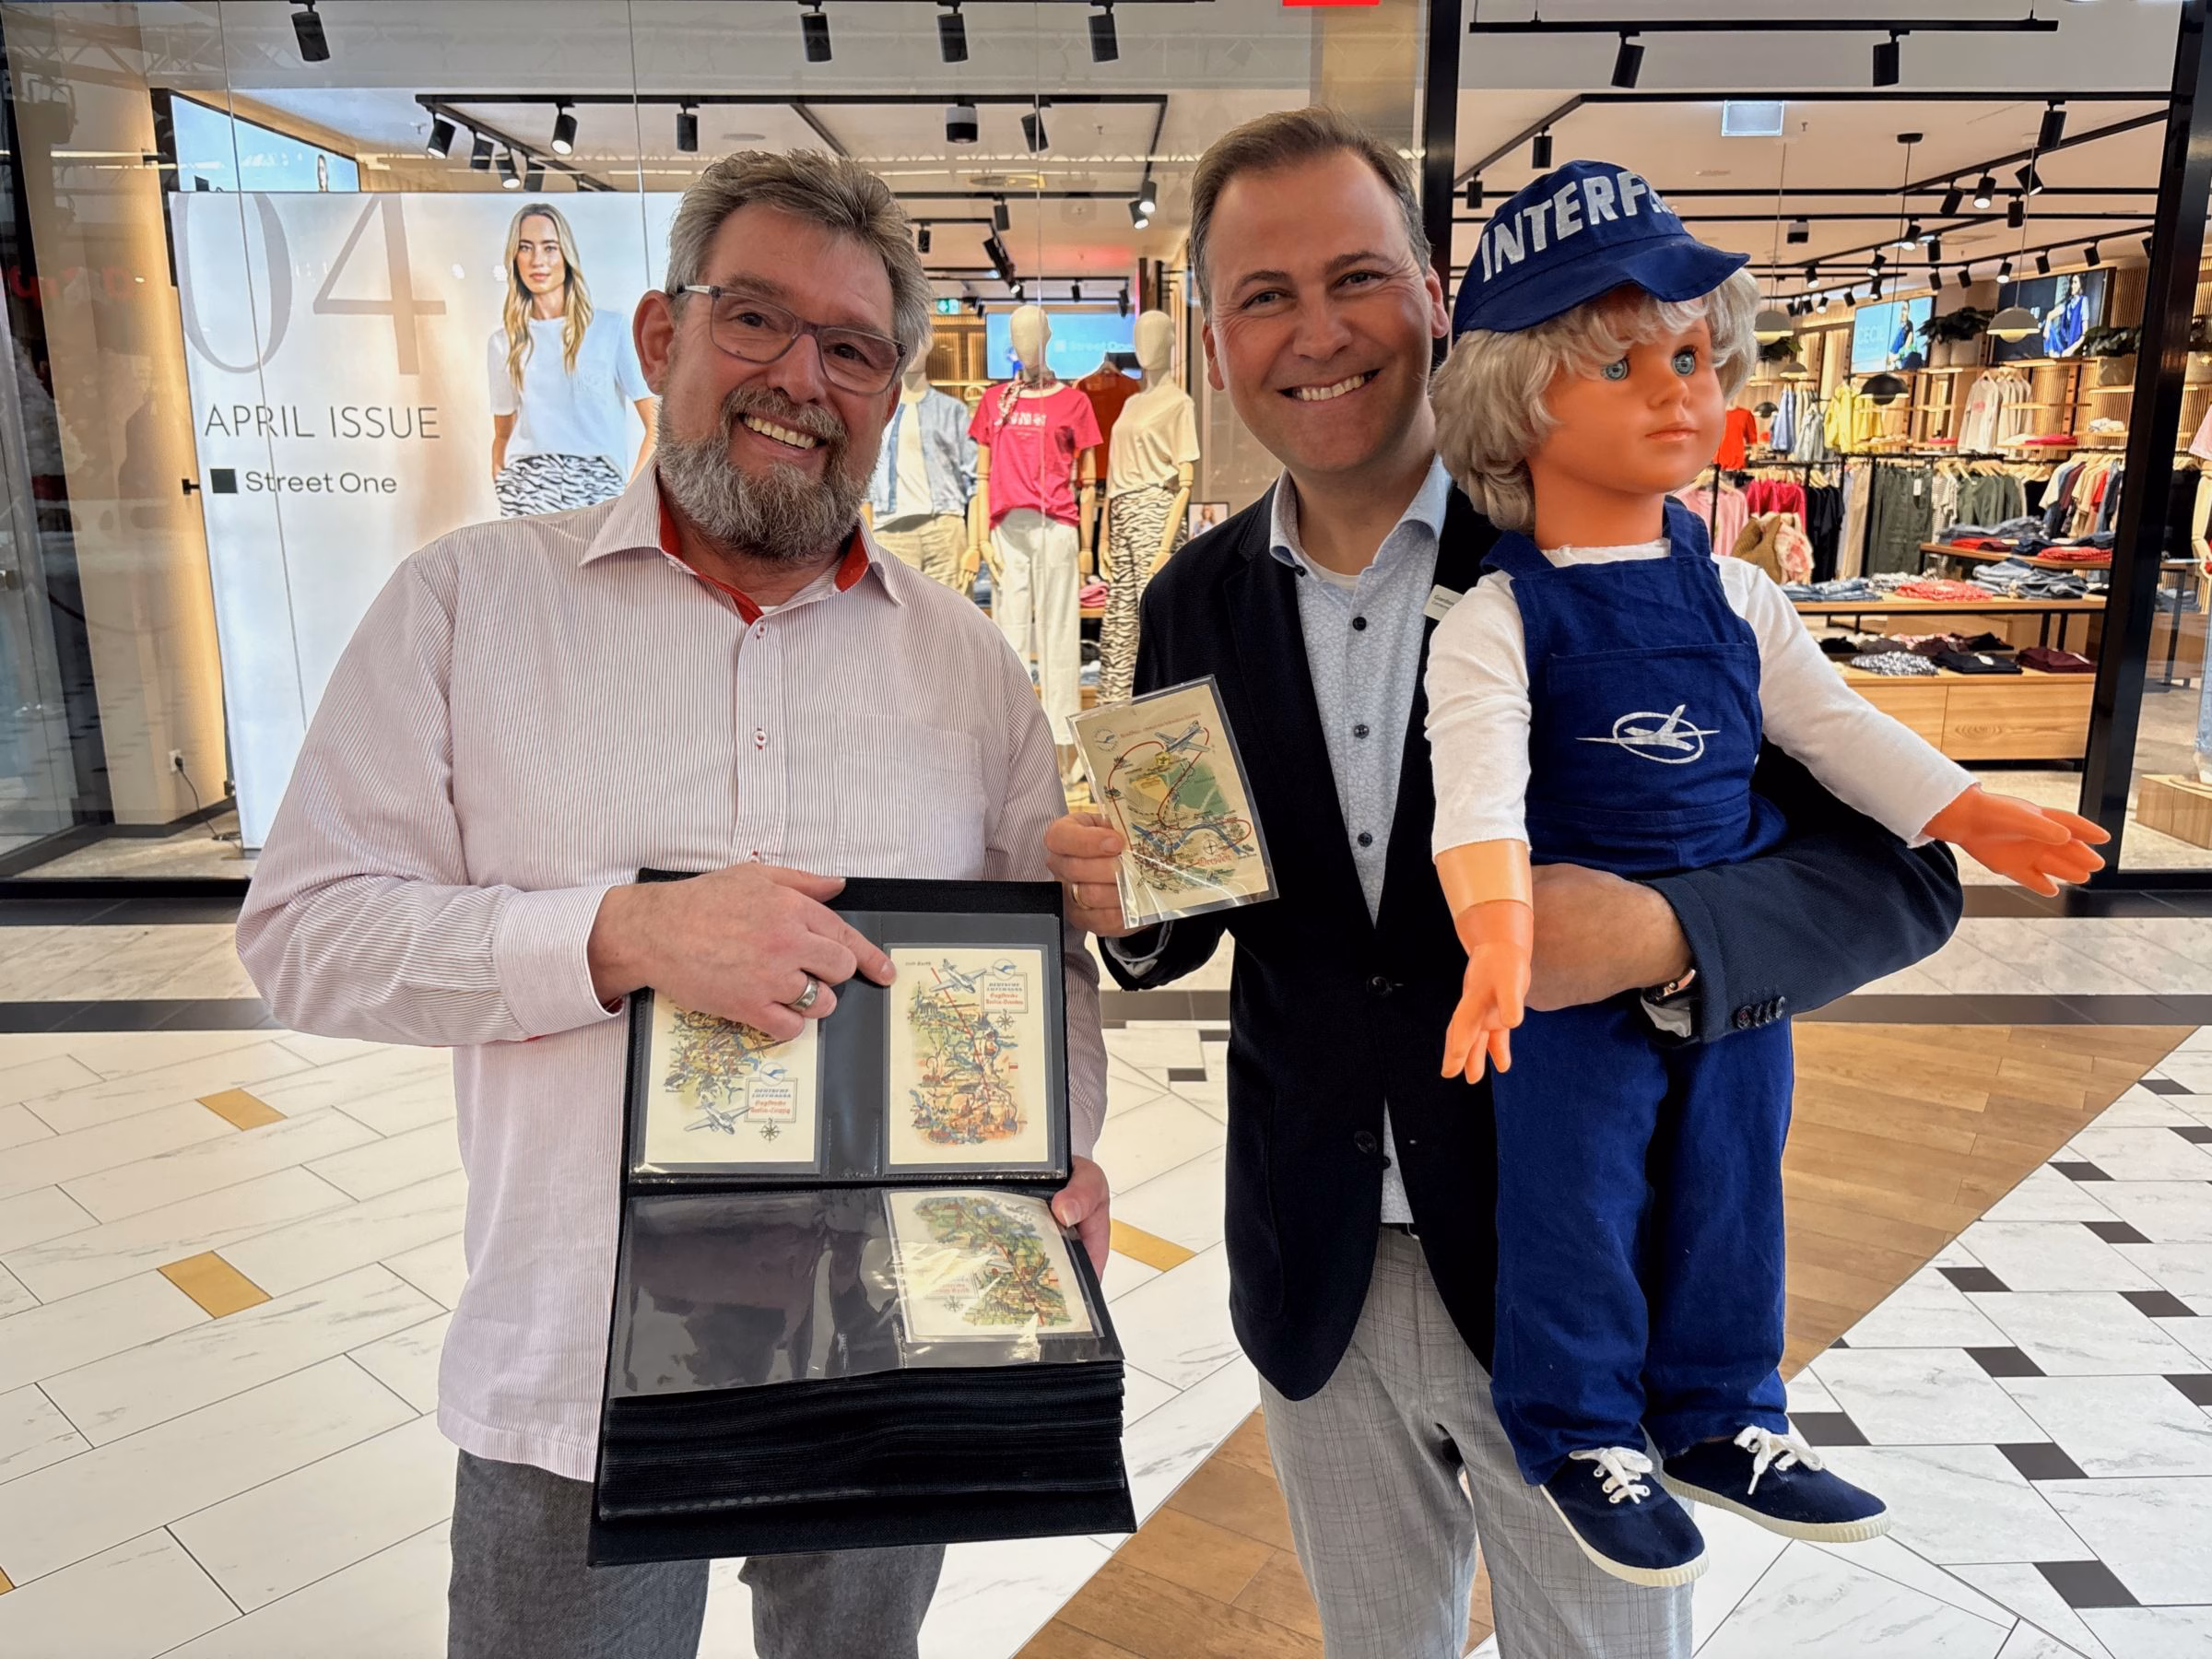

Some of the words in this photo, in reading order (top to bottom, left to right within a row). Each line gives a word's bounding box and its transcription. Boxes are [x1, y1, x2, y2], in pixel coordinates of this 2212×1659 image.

[171, 192, 447, 375] 04
[205, 404, 315, 438] APRIL
[330, 406, 441, 439] ISSUE
[245, 471, 335, 492] Street
[339, 472, 397, 493] One
